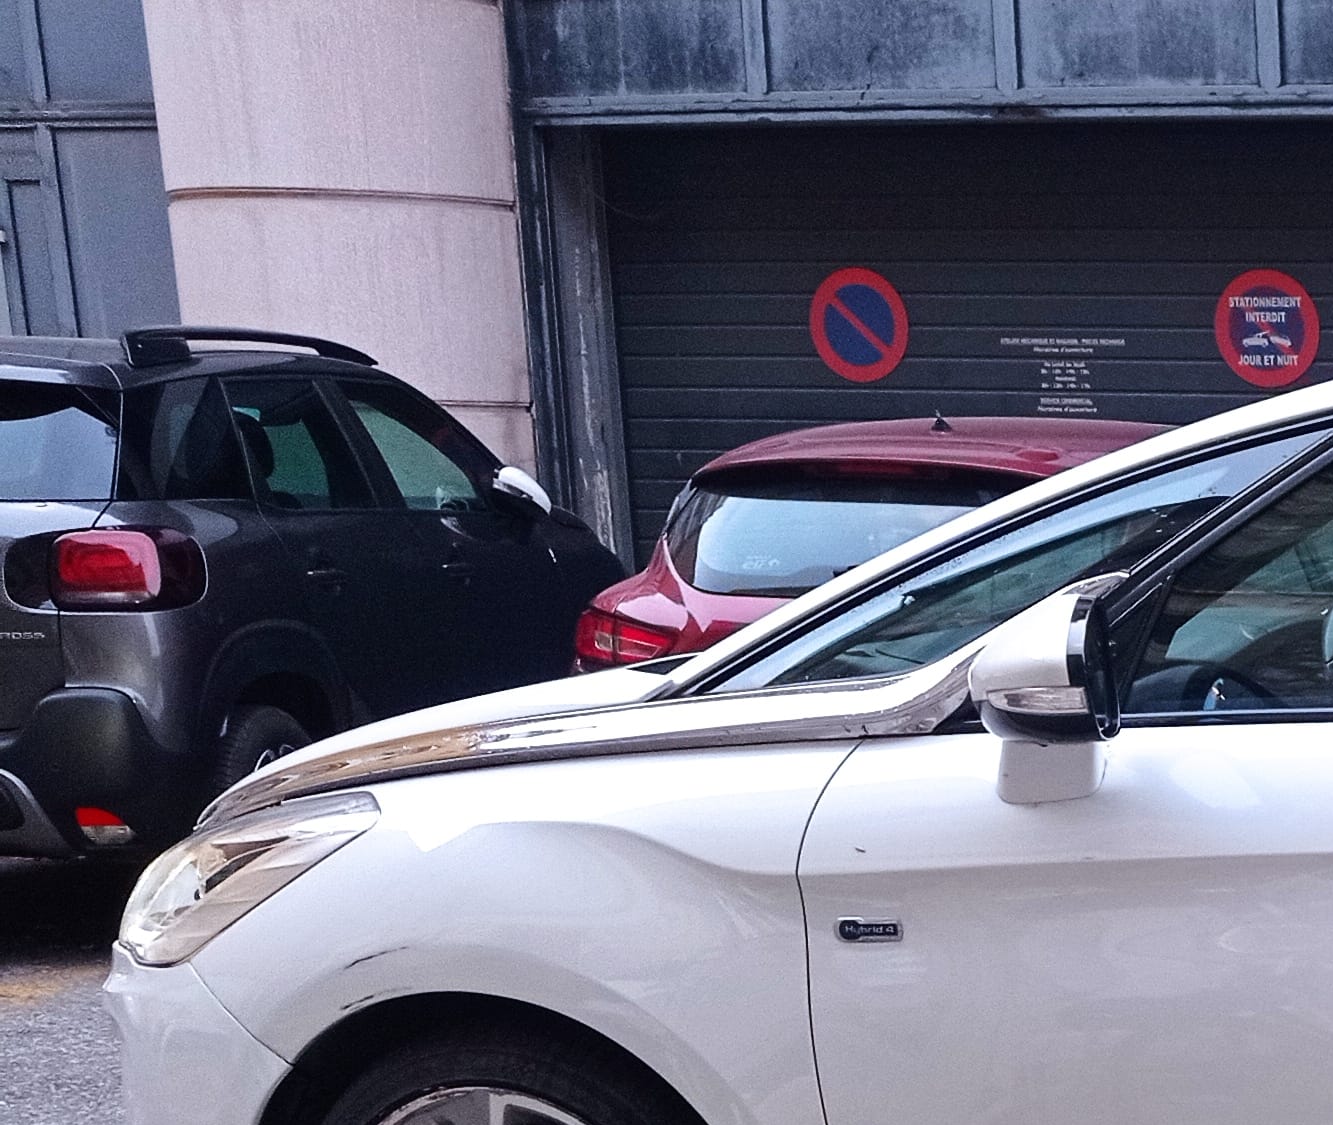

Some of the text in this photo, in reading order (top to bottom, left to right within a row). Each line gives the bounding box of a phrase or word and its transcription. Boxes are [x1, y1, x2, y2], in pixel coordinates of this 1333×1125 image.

[1229, 296, 1302, 308] STATIONNEMENT
[1245, 311, 1286, 322] INTERDIT
[1238, 354, 1299, 366] JOUR ET NUIT
